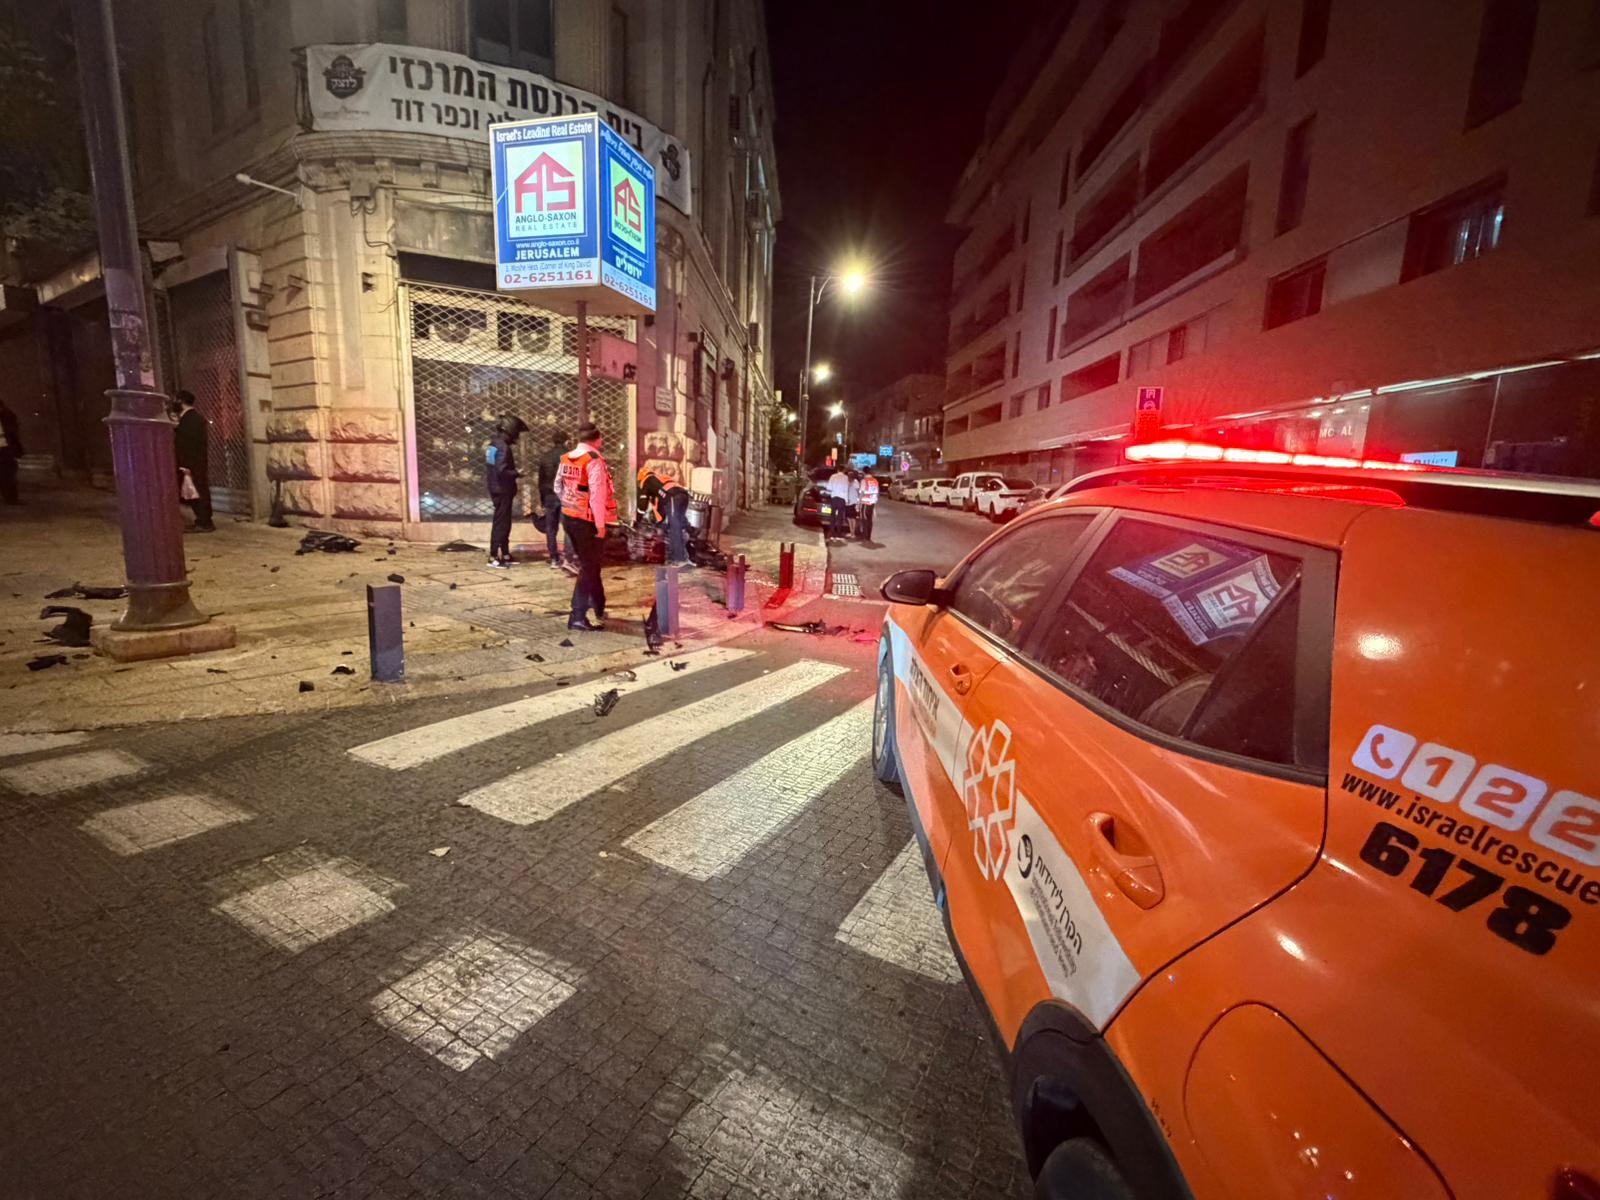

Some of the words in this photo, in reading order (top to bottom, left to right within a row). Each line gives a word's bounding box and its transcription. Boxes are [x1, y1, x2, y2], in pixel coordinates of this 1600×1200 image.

[389, 56, 497, 102] המרכזי
[391, 98, 424, 122] דוד
[431, 102, 479, 129] וכפר
[496, 128, 522, 142] Israel's
[523, 126, 551, 140] Leading
[551, 124, 568, 136] Real
[568, 122, 593, 135] Estate
[607, 110, 642, 151] בית
[515, 211, 577, 224] ANGLO-SAXON
[515, 224, 538, 232] REAL
[543, 221, 577, 230] ESTATE
[515, 246, 580, 261] JERUSALEM
[504, 269, 593, 284] 02-6251161
[603, 273, 654, 306] 02-6251161
[1035, 855, 1064, 910] לידידות
[1359, 821, 1573, 956] 6178
[1059, 906, 1082, 955] הקרן
